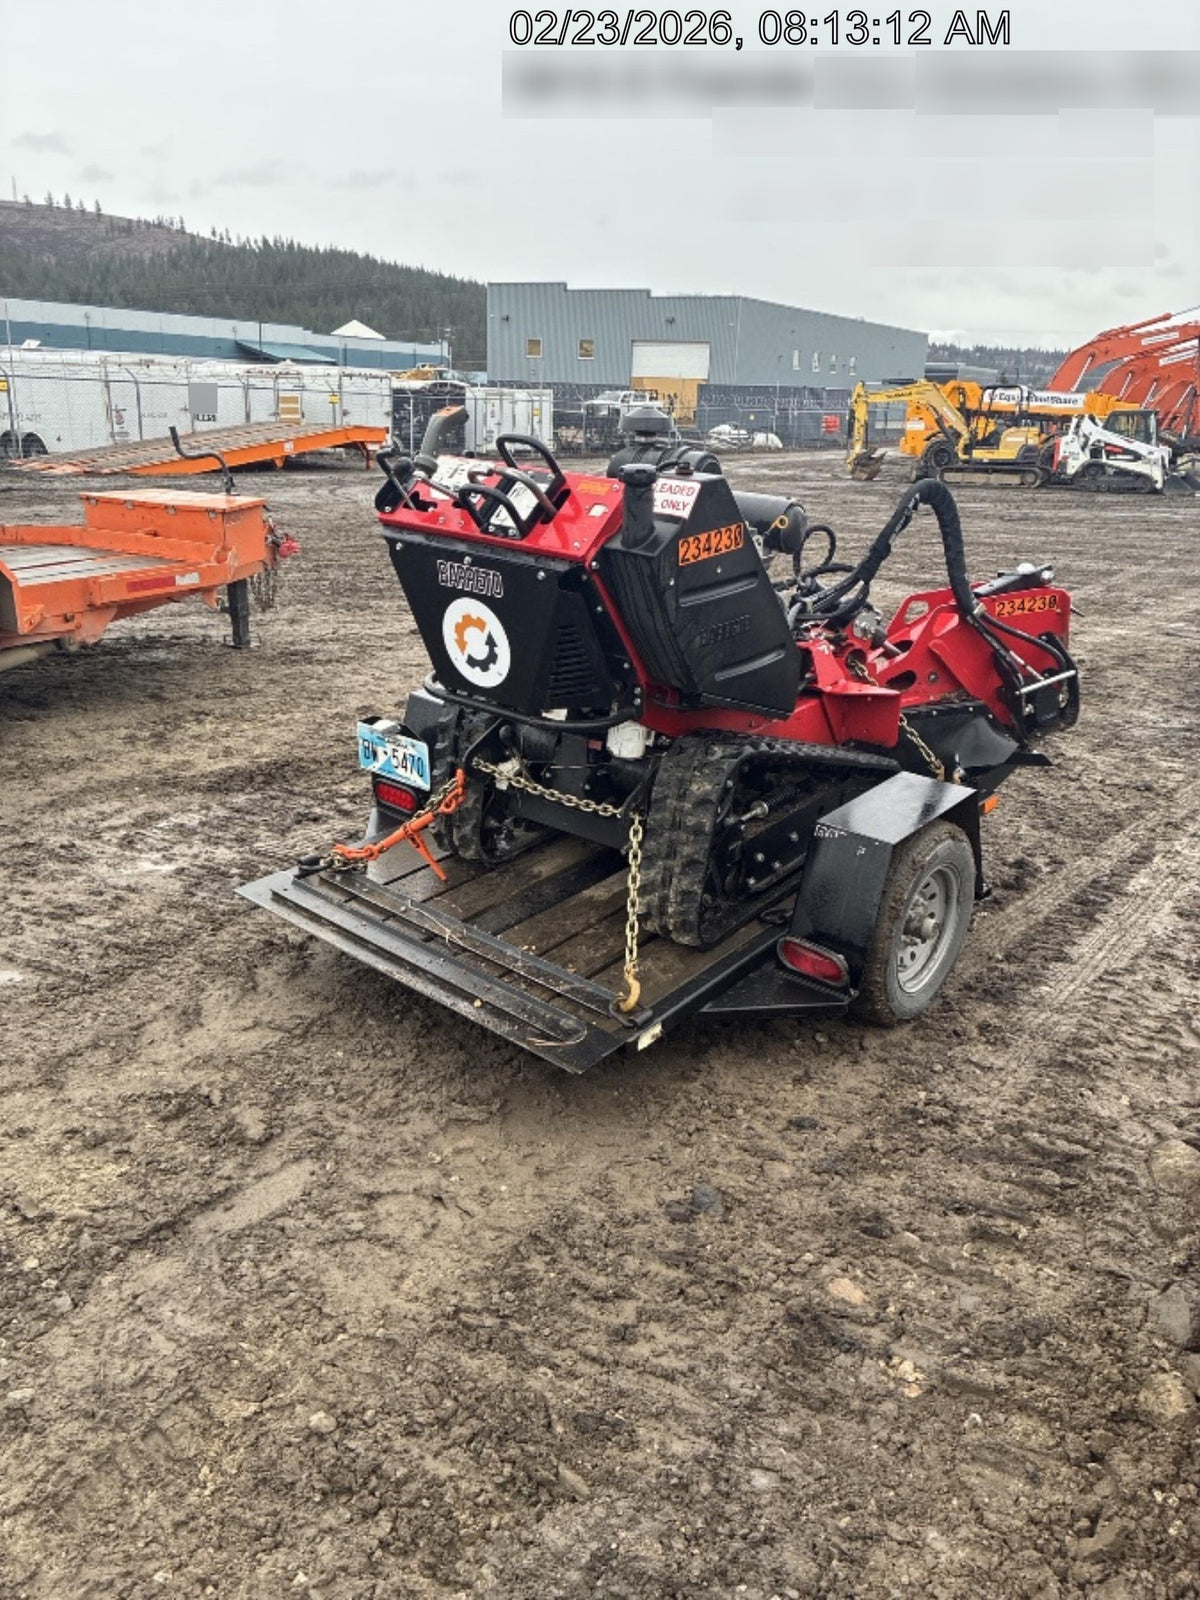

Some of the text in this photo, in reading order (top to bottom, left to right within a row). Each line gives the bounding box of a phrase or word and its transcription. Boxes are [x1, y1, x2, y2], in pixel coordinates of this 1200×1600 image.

[661, 499, 690, 511] ONLY
[680, 525, 742, 564] 234230
[437, 560, 503, 598] BARRETO
[996, 595, 1057, 617] 234230
